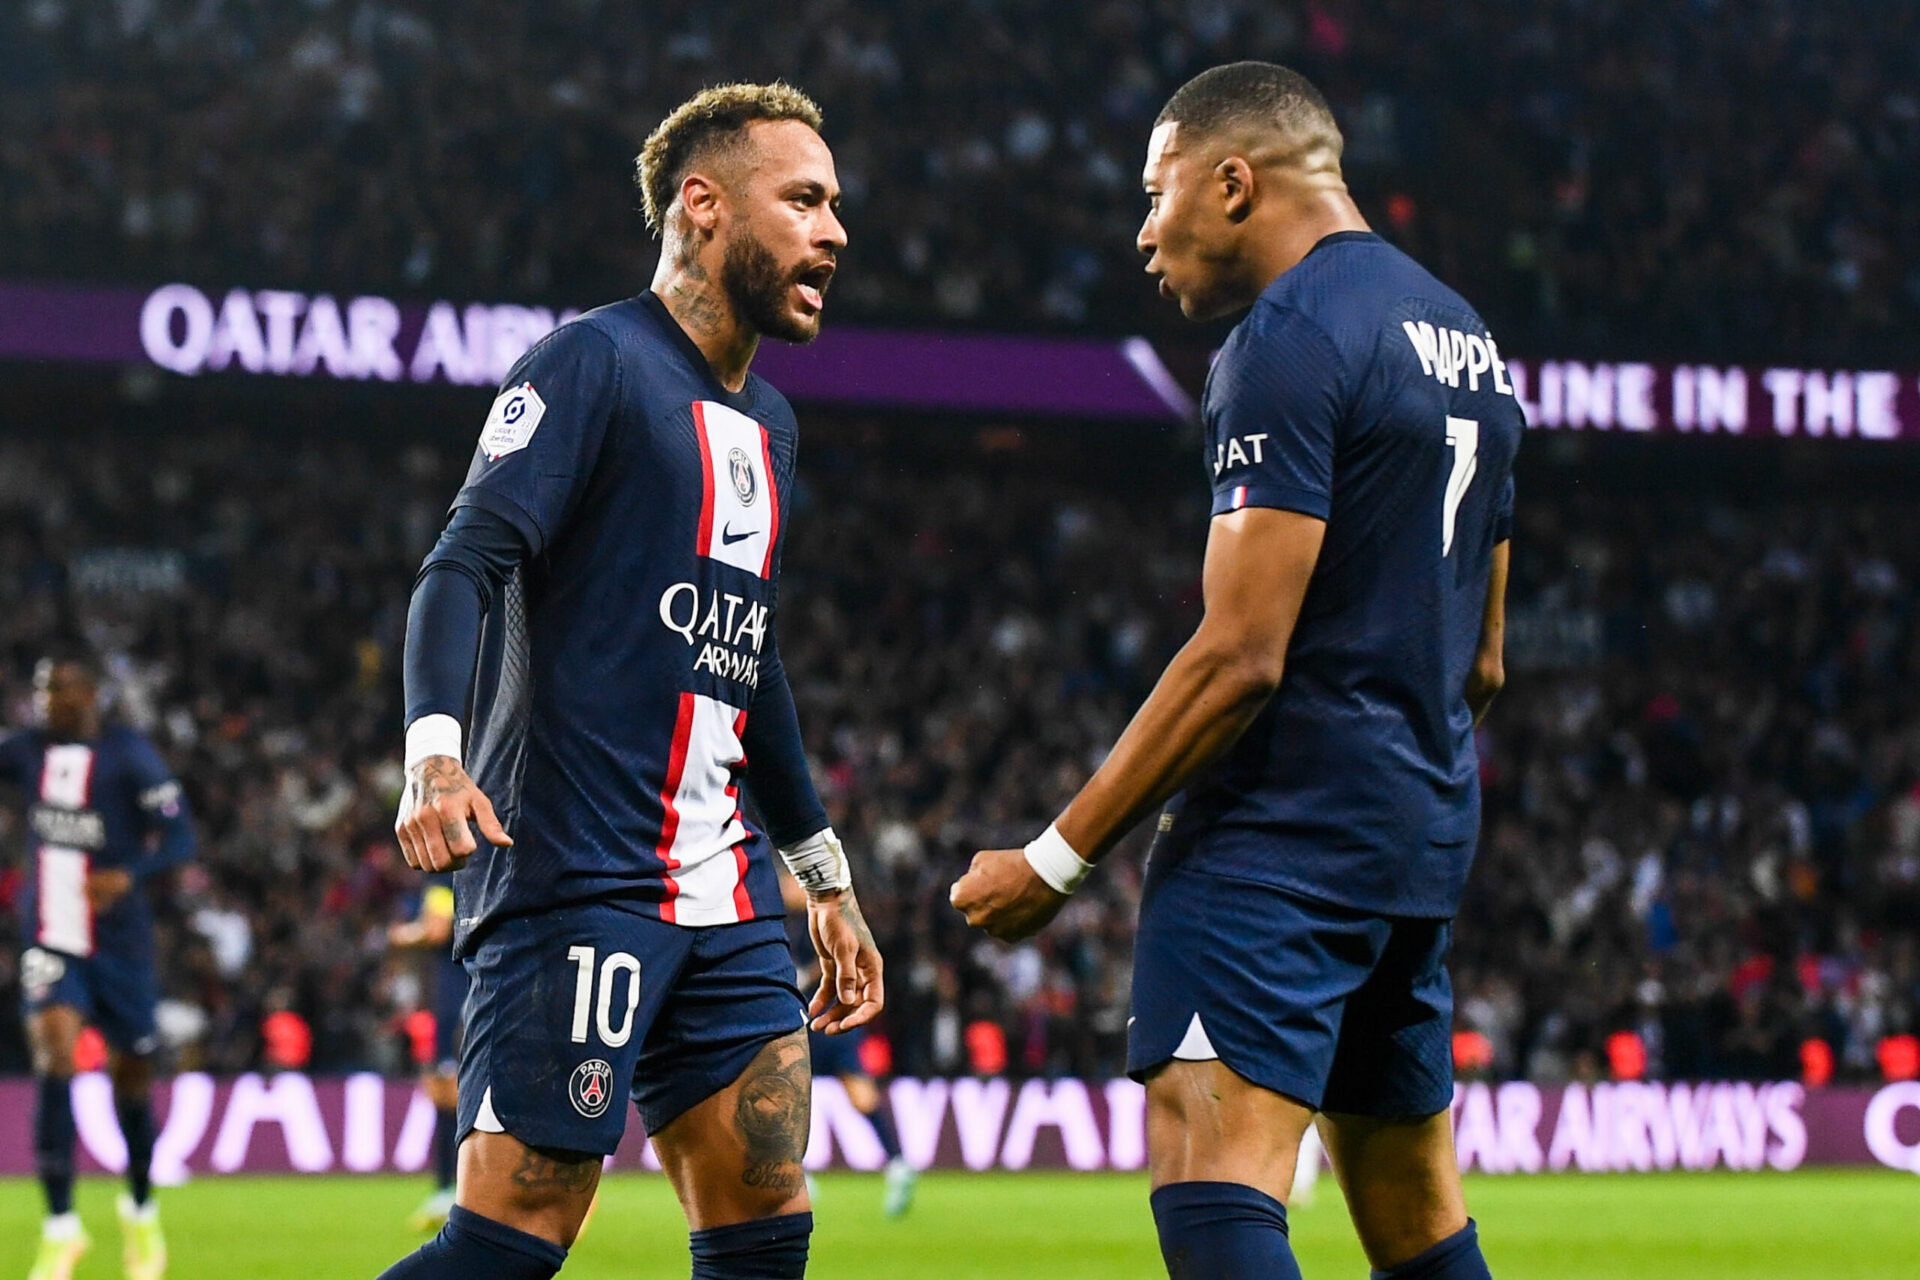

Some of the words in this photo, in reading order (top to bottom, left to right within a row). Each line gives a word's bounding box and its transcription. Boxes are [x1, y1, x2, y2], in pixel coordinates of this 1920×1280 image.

[140, 283, 403, 381] QATAR
[1672, 364, 1748, 433] IN
[1762, 368, 1901, 440] THE
[1443, 414, 1479, 558] 7
[567, 945, 641, 1048] 10
[580, 1062, 610, 1078] PARIS
